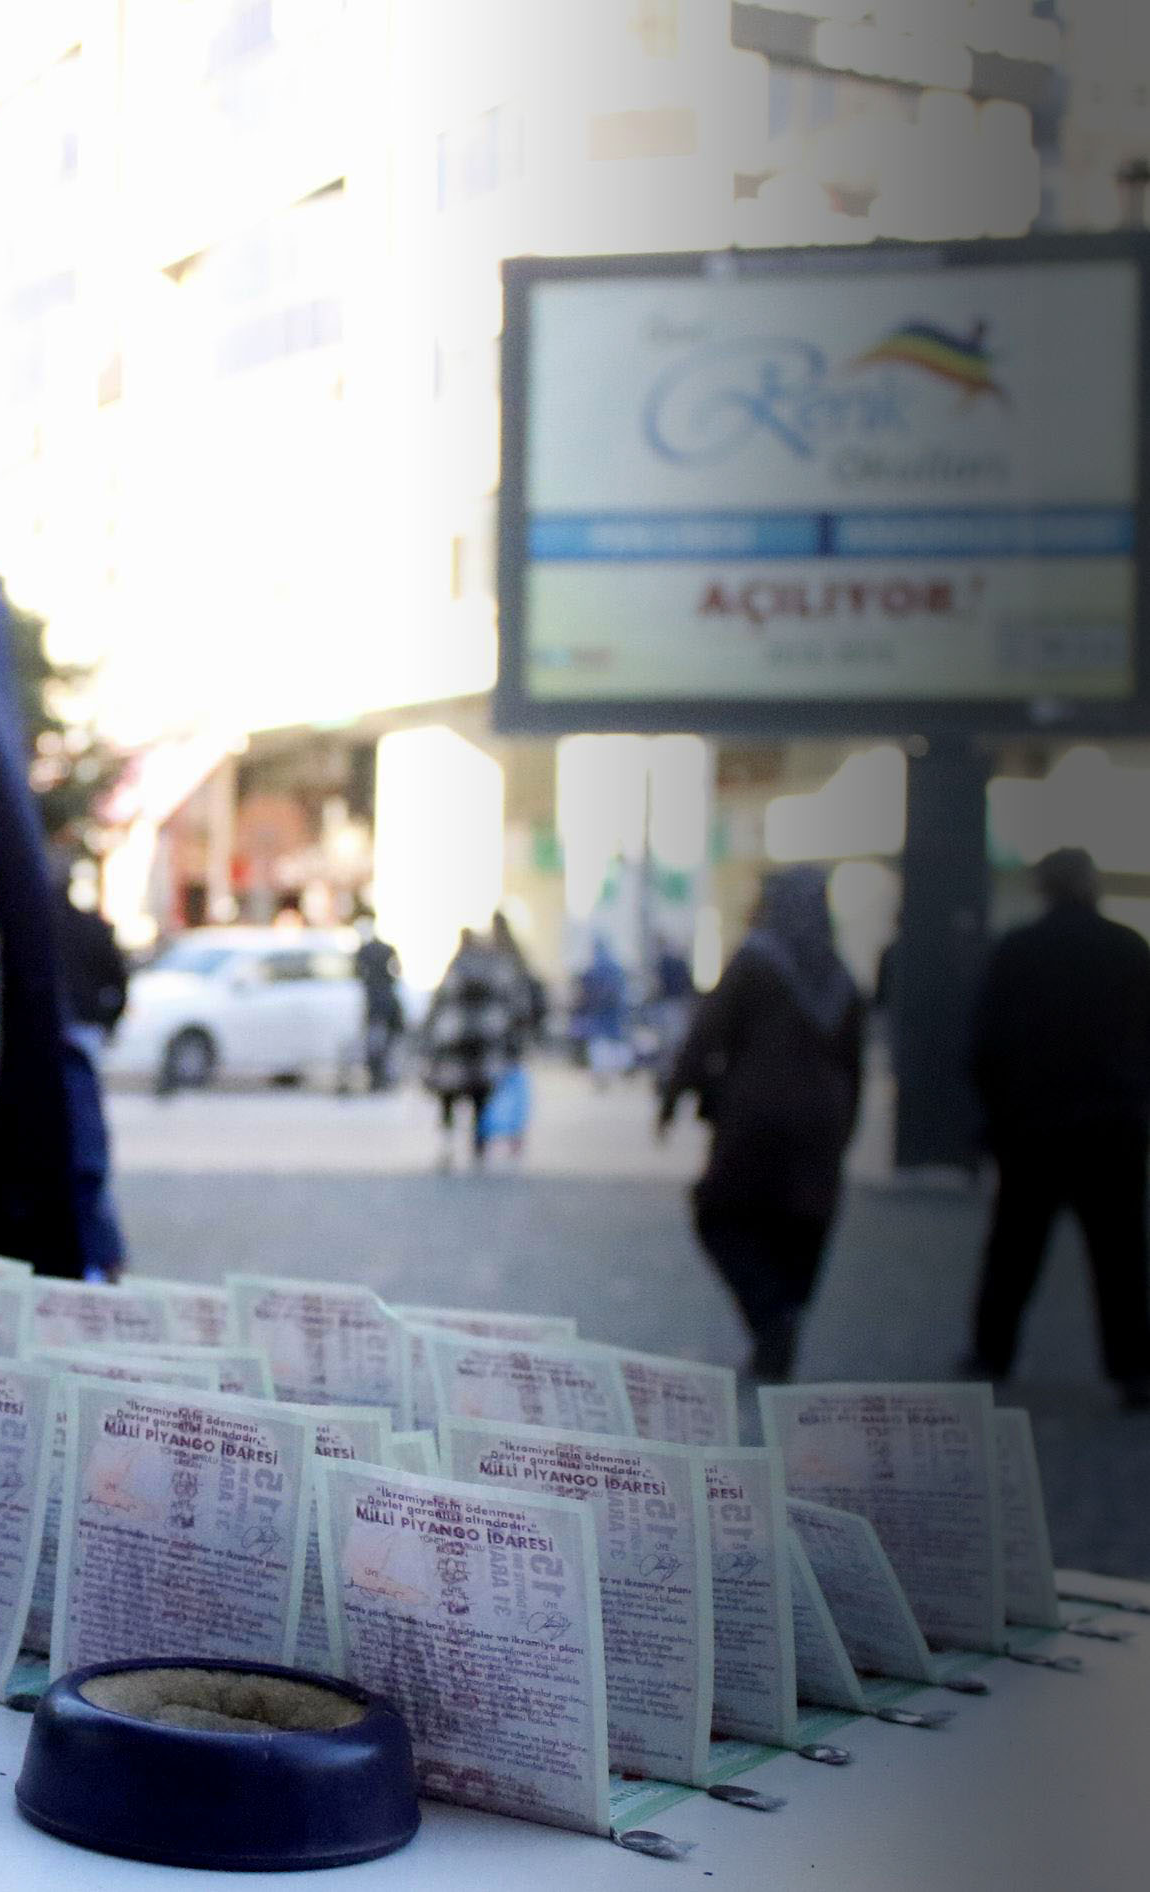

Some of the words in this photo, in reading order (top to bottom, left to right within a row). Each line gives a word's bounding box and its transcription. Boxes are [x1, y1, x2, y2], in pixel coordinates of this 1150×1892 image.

[116, 1409, 149, 1423] Devlet
[104, 1420, 140, 1439] MİLLİ
[145, 1427, 215, 1452] PİYANGO
[221, 1440, 278, 1465] İDARESİ
[314, 1445, 355, 1460] ARESİ
[490, 1450, 526, 1463] Devlet
[585, 1451, 641, 1467] ödenmesi
[479, 1461, 518, 1477] MİLLİ
[524, 1464, 598, 1487] PİYANGO
[605, 1475, 666, 1496] İDARESİ
[707, 1485, 743, 1500] RESİ
[368, 1496, 403, 1511] Devlet
[466, 1504, 525, 1521] ödenmesi
[356, 1505, 394, 1526] MİLLİ
[401, 1515, 480, 1541] PİYANGO
[487, 1528, 553, 1553] İDARESİ
[511, 1635, 556, 1650] ikramiye
[559, 1644, 584, 1655] planı
